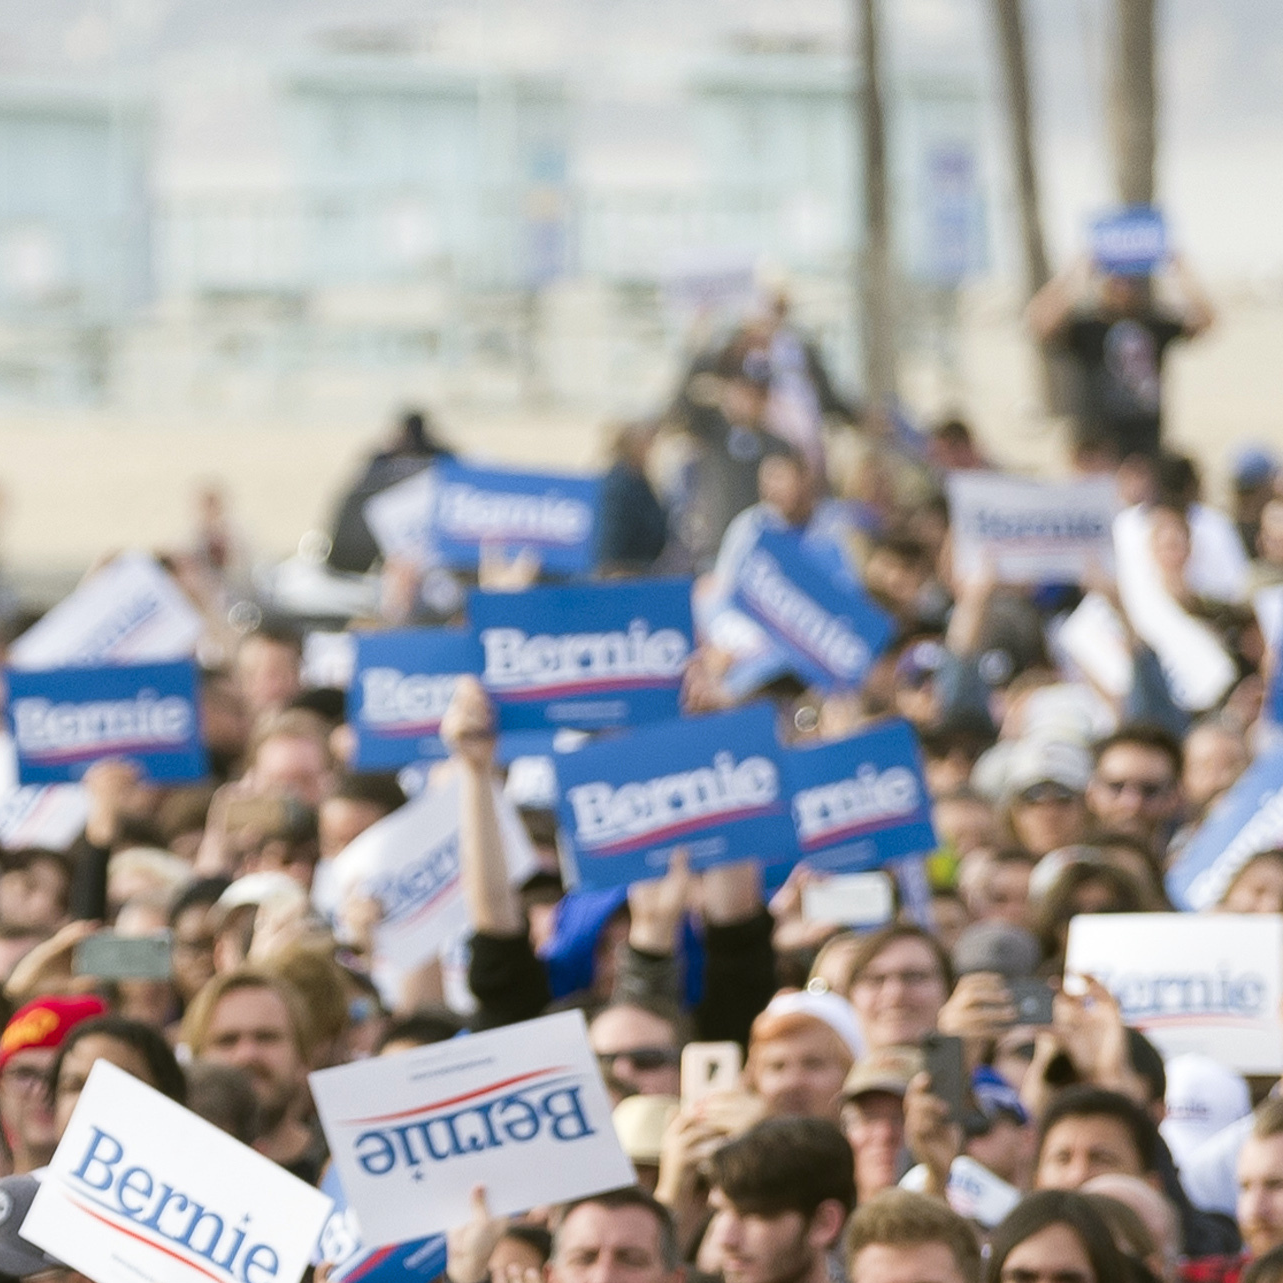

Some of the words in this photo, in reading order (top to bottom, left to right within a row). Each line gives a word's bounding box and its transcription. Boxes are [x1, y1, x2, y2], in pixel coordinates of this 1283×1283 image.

[438, 482, 592, 542] Bernie
[738, 547, 871, 679] Bernie
[480, 619, 689, 687] Bernie
[13, 689, 191, 752] Bernie
[568, 751, 779, 844] Bernie
[792, 763, 918, 839] rnie
[1106, 962, 1266, 1016] ernie
[354, 1085, 597, 1182] Bernie
